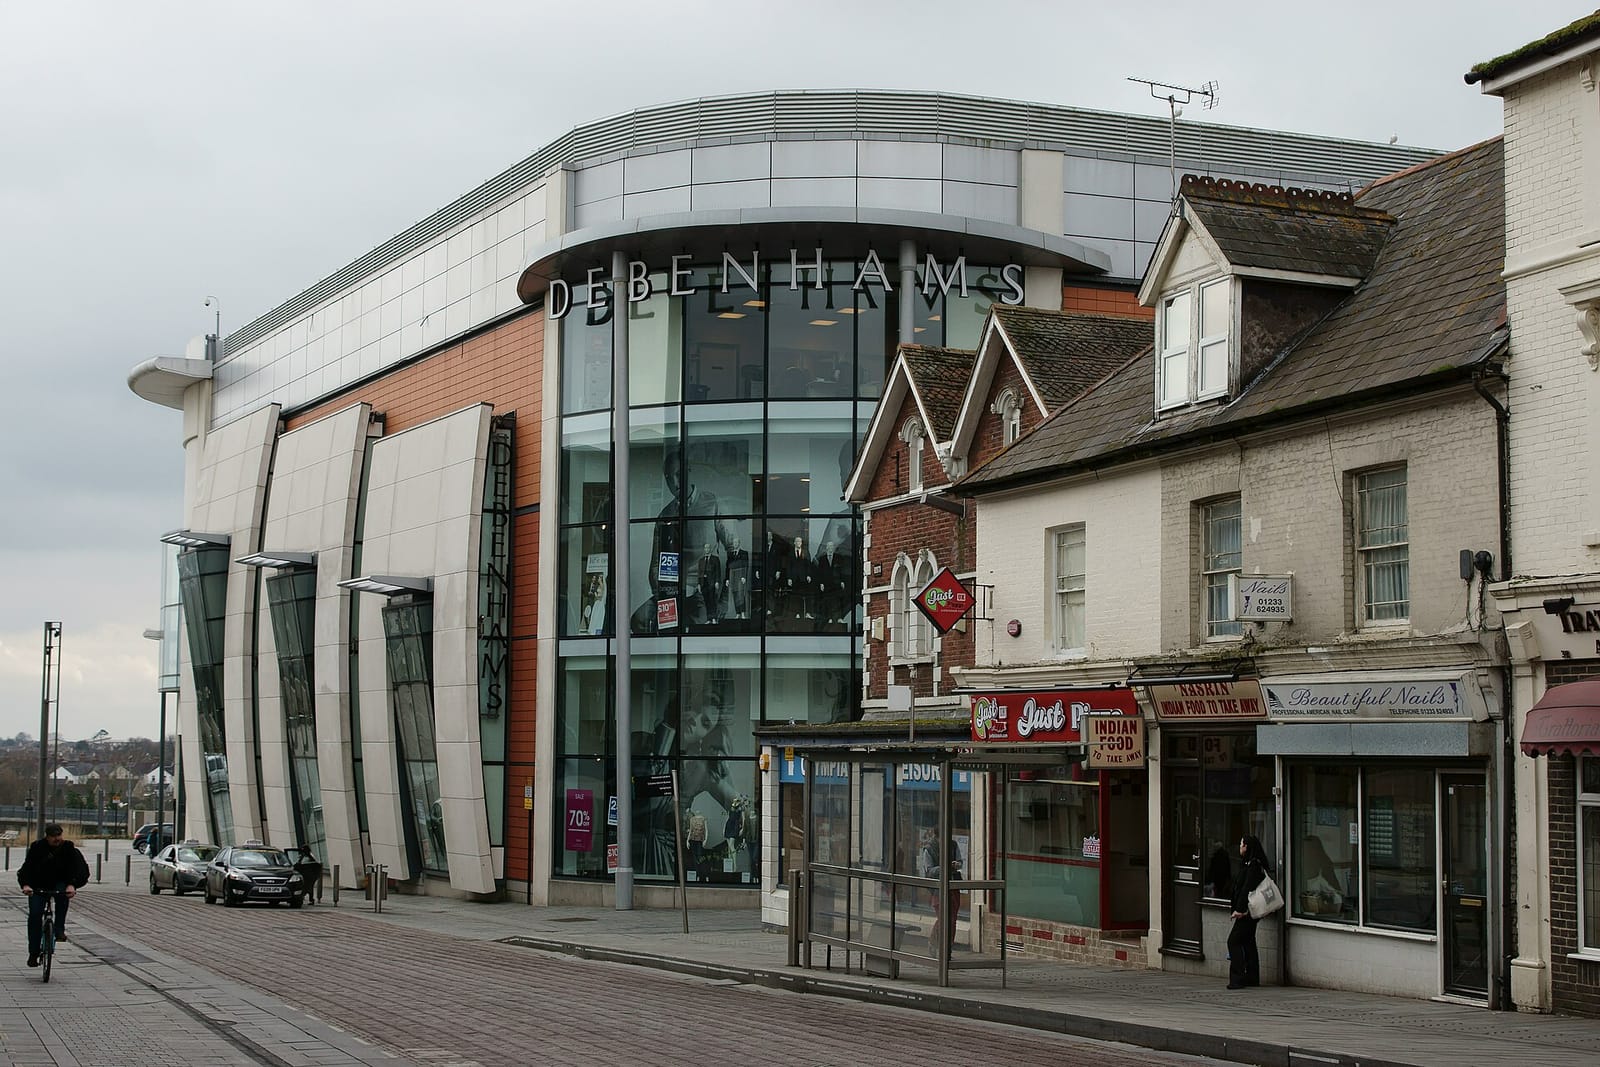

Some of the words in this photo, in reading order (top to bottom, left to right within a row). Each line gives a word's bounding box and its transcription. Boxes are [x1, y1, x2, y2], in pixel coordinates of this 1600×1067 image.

[549, 247, 1025, 321] DEBENHAMS
[481, 441, 511, 710] DEBENHAMS
[1240, 580, 1288, 594] Nails
[927, 588, 954, 605] Just
[1258, 598, 1282, 606] 01233
[1161, 700, 1185, 715] INDIAN
[1185, 699, 1206, 715] FOOD
[1206, 699, 1219, 715] TO
[1218, 698, 1239, 714] TAKE
[1239, 697, 1259, 713] AWAY
[1288, 686, 1392, 710] Beautiful
[1389, 686, 1445, 706] Nails
[976, 697, 999, 728] Just
[1017, 697, 1066, 737] Just
[1095, 720, 1138, 735] INDIAN
[1099, 736, 1134, 750] FOOD
[1093, 750, 1102, 760] TO
[1107, 754, 1123, 763] TAKE
[1126, 750, 1142, 762] AWAY
[902, 763, 941, 781] EISUR
